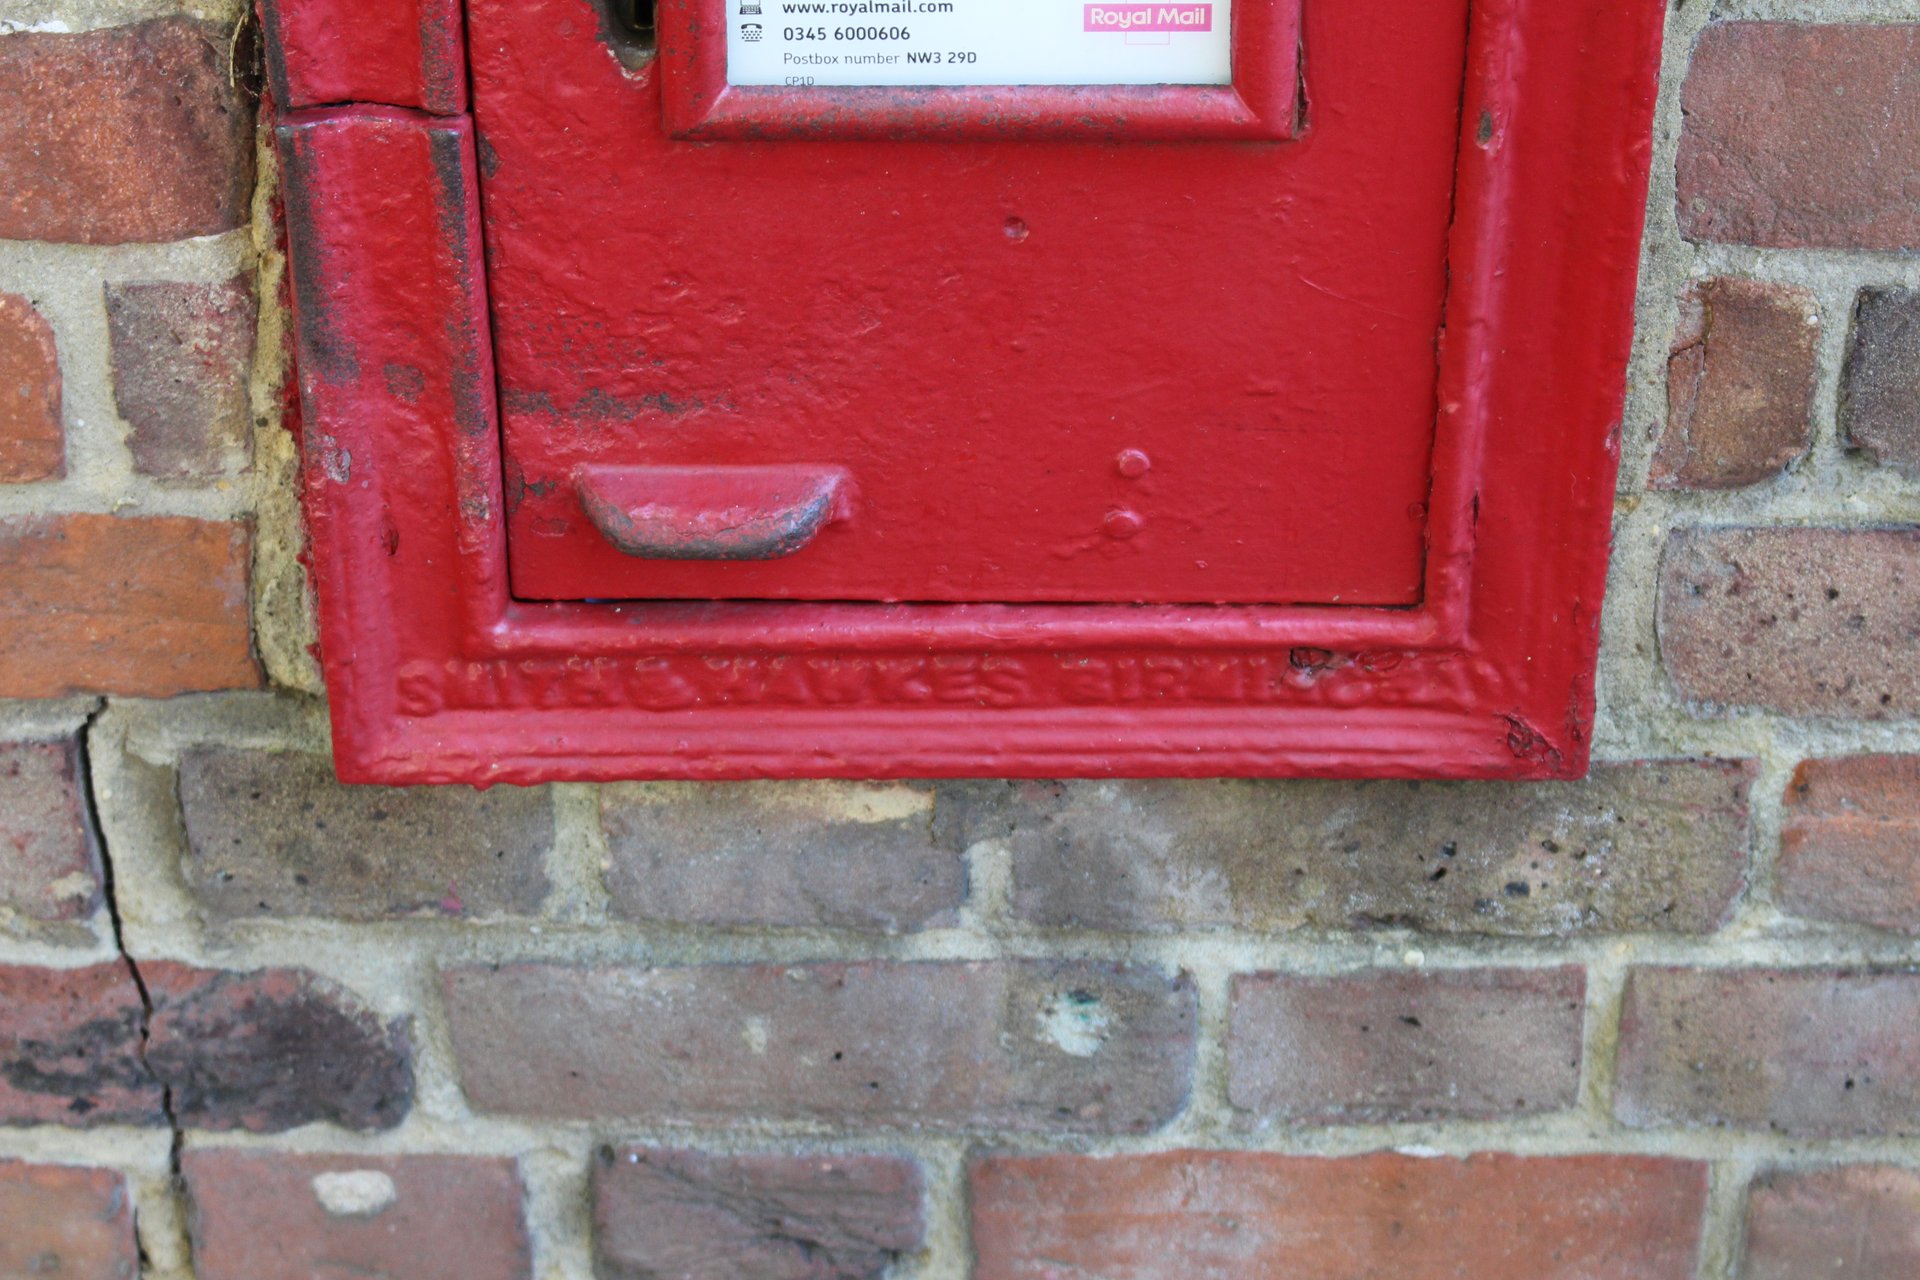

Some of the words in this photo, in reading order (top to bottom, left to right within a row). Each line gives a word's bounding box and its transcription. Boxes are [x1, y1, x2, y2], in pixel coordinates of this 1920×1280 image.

[782, 0, 954, 16] www.royalmail.com
[1090, 7, 1152, 29] Royal
[1156, 7, 1205, 25] Mail
[783, 27, 827, 41] 0345
[834, 26, 911, 41] 6000606
[783, 52, 840, 65] Postbox
[844, 52, 900, 65] number
[906, 51, 942, 64] NW3
[947, 51, 977, 64] 29D
[784, 75, 815, 86] CP1D
